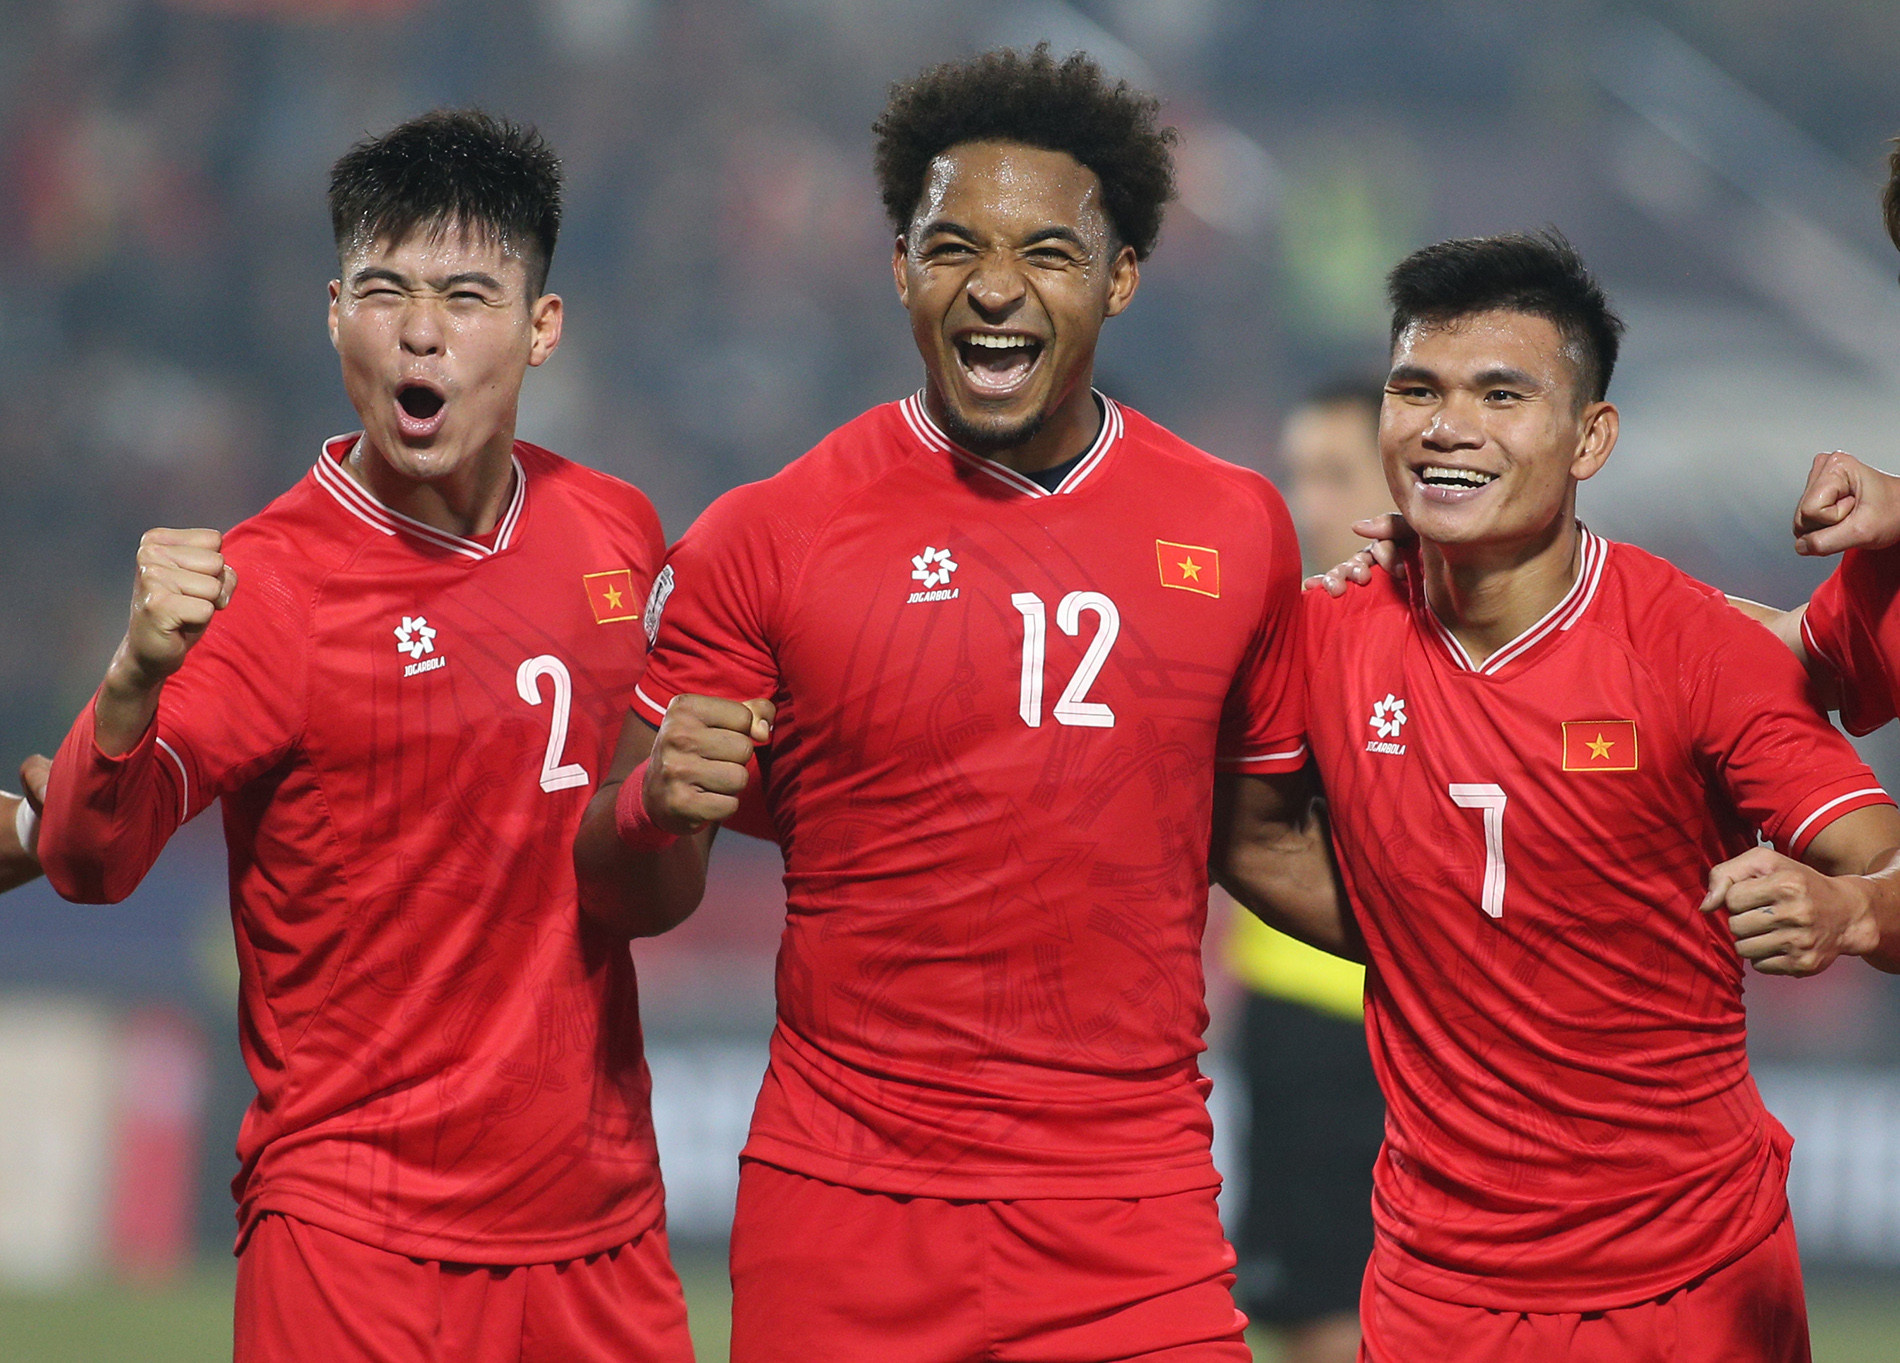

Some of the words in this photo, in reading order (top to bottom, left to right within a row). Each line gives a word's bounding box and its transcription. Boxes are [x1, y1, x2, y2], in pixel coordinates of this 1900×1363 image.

[907, 588, 959, 604] JOGARBOLA
[404, 657, 445, 676] JOGARBOLA
[1011, 591, 1120, 727] 12
[516, 655, 589, 793] 2
[1365, 741, 1406, 755] JOGARBOLA
[1449, 784, 1507, 918] 7
